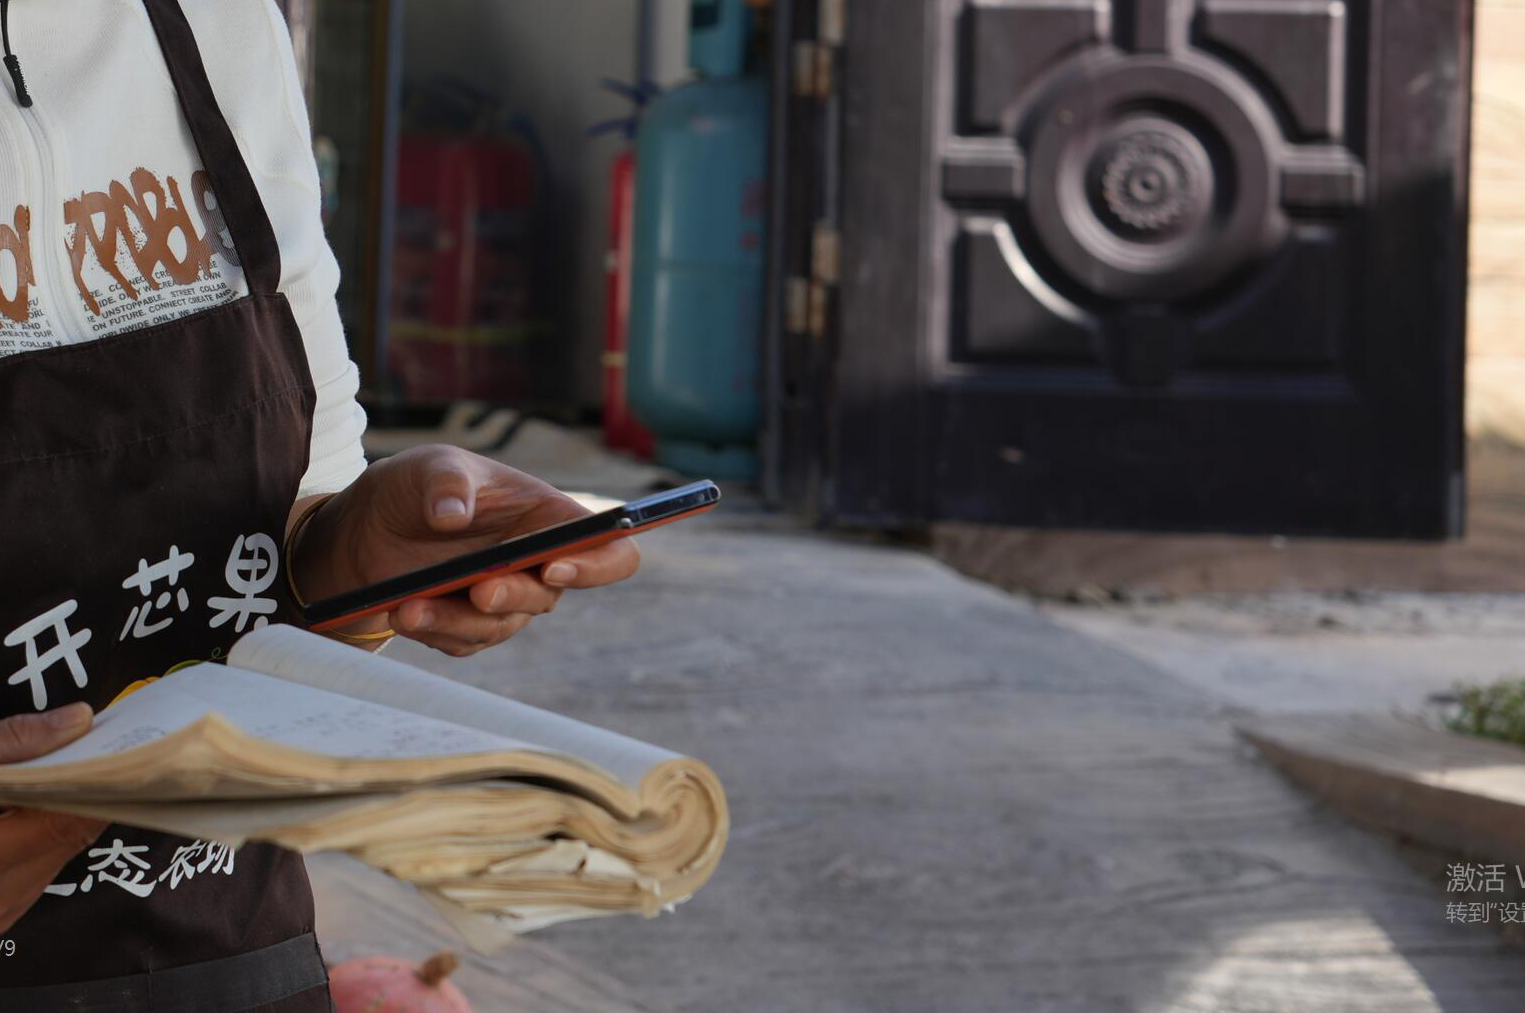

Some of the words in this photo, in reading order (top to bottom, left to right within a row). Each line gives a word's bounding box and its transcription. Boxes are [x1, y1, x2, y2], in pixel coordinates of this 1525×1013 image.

[170, 288, 196, 298] STREET
[199, 282, 227, 293] COLLAB
[92, 323, 107, 332] ON
[148, 298, 186, 313] CONNECT
[187, 294, 214, 304] CREATE
[152, 312, 176, 324] ONLY
[33, 329, 54, 339] OUR
